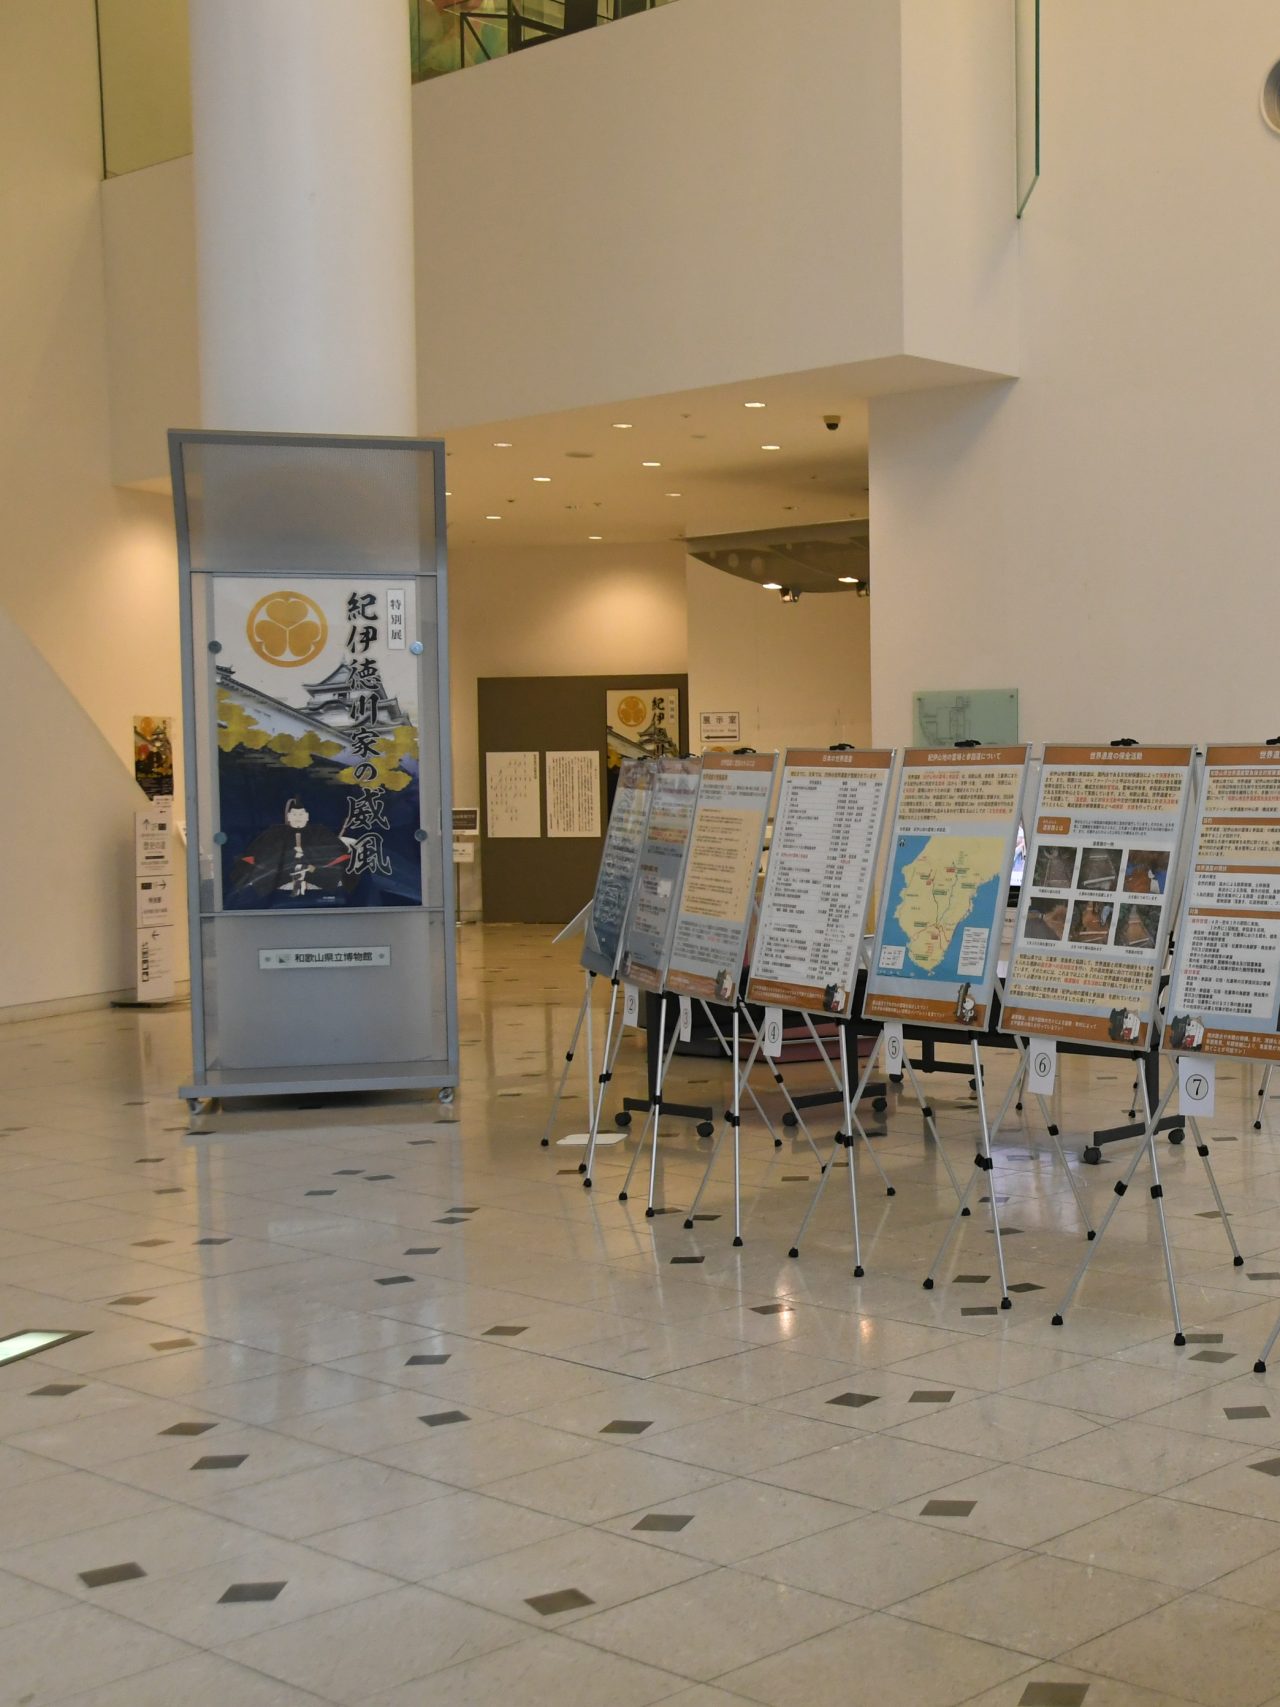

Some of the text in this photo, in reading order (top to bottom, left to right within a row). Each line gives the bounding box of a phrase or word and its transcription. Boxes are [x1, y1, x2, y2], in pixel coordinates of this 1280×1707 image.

[390, 598, 403, 640] 特別展
[345, 591, 392, 875] 紀伊徳川家の威風
[703, 715, 736, 724] 展示室
[295, 951, 373, 963] 和歌山県立博物館
